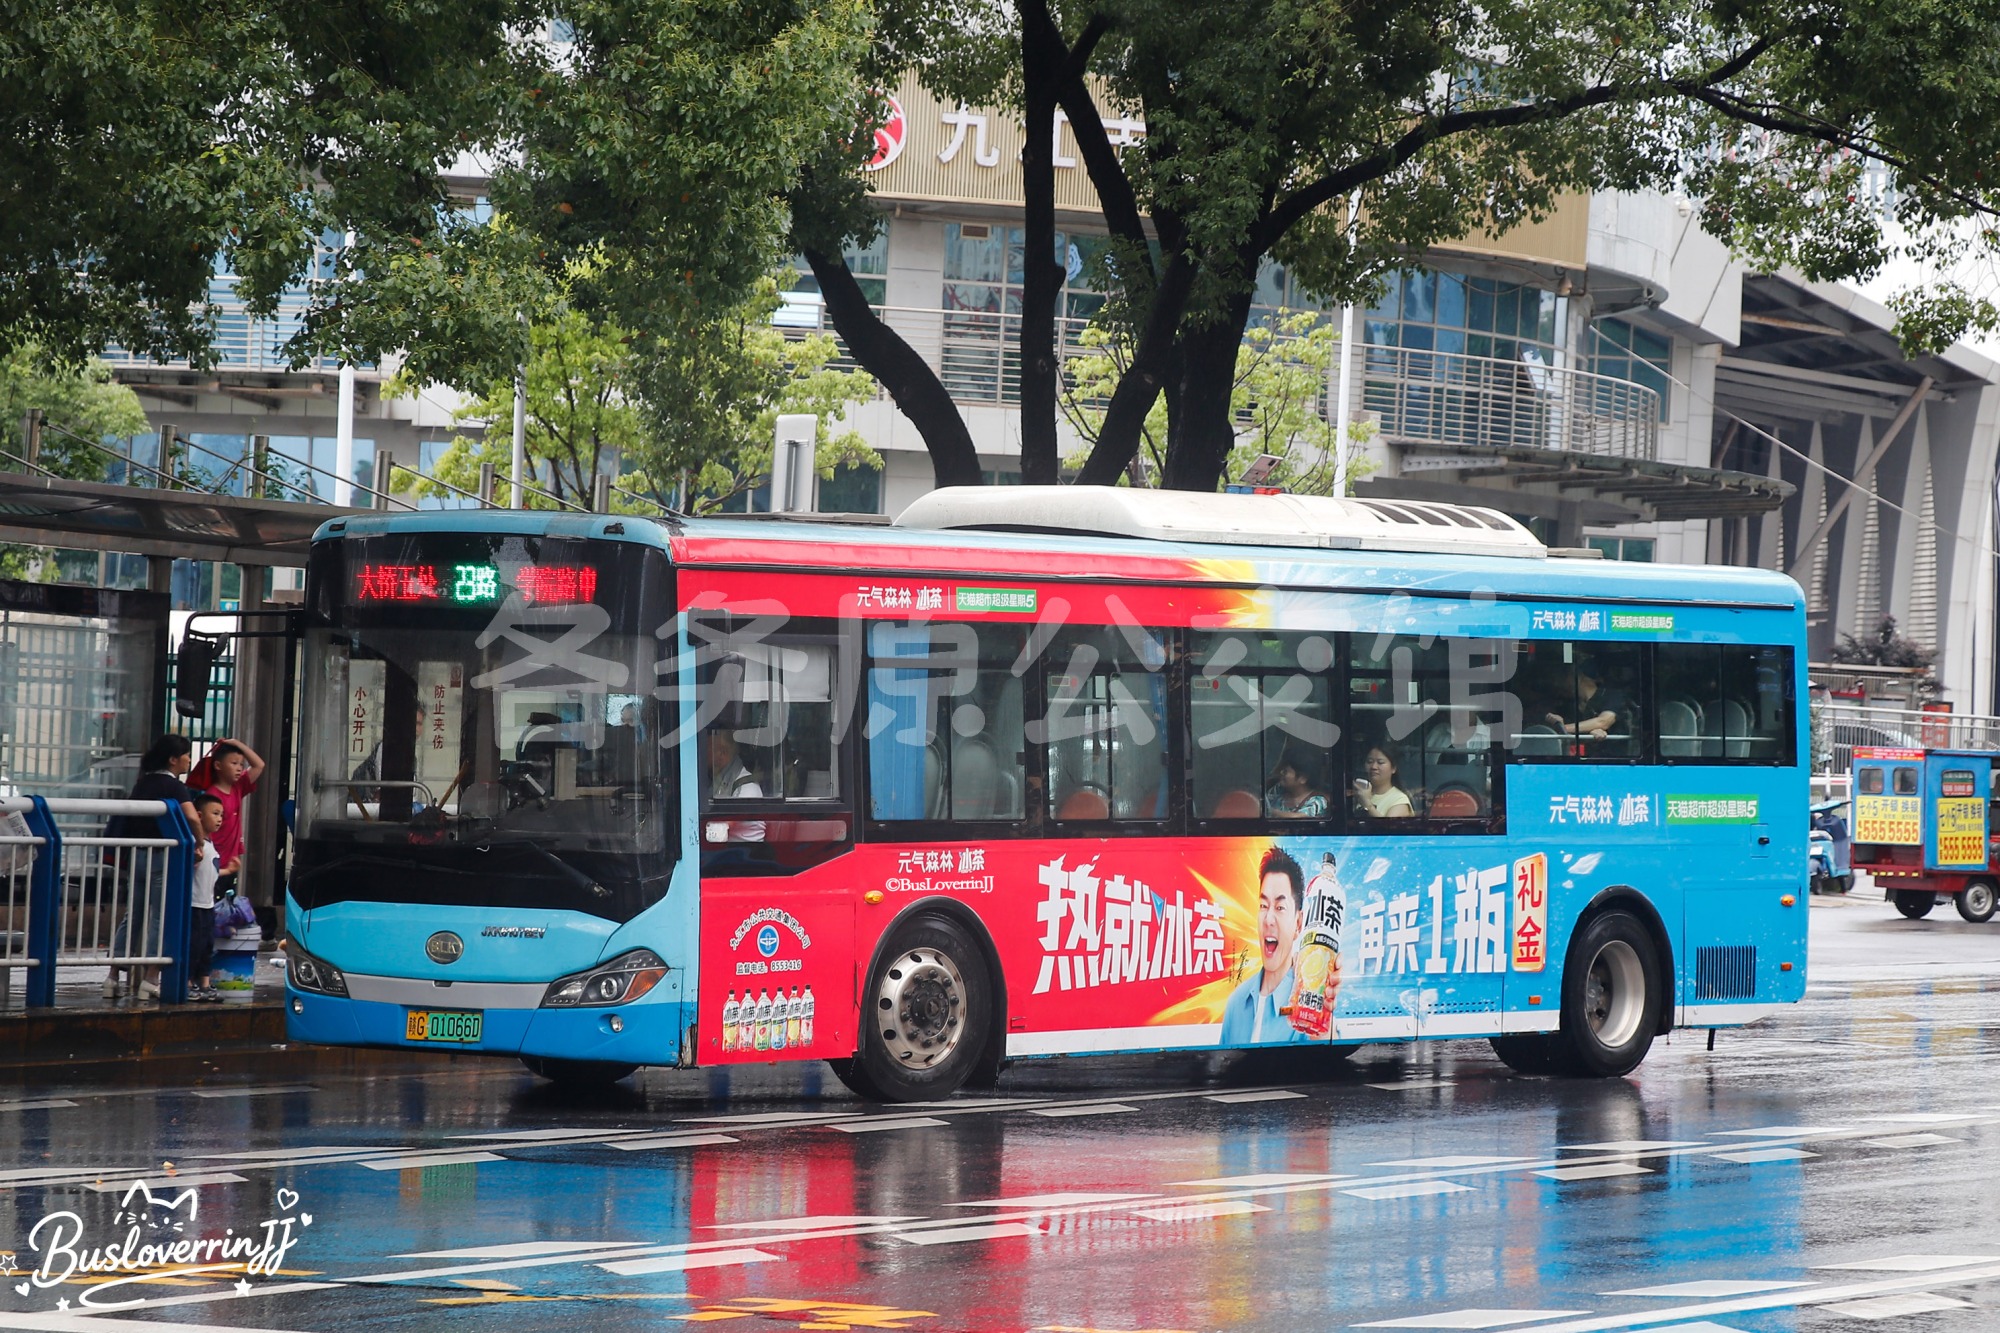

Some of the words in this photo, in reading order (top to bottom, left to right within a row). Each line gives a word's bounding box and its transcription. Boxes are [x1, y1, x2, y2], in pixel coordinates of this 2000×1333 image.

[857, 586, 912, 608] 元气森林
[916, 586, 943, 610] 冰茶
[958, 592, 1035, 608] 天猫超市超级星期5
[1533, 610, 1576, 630] 元气森林
[352, 686, 366, 753] 小心开门
[432, 684, 445, 750] 防止夹伤
[1549, 795, 1613, 824] 元气森林
[1618, 793, 1650, 825] 冰茶
[1667, 800, 1758, 820] 天猫超市超级星期5
[898, 850, 954, 873] 元气森林
[958, 848, 985, 873] 冰茶
[1032, 853, 1225, 994] 热就冰茶
[1358, 863, 1507, 975] 再来1瓶
[1516, 864, 1543, 964] 礼金
[770, 960, 802, 972] 8553416
